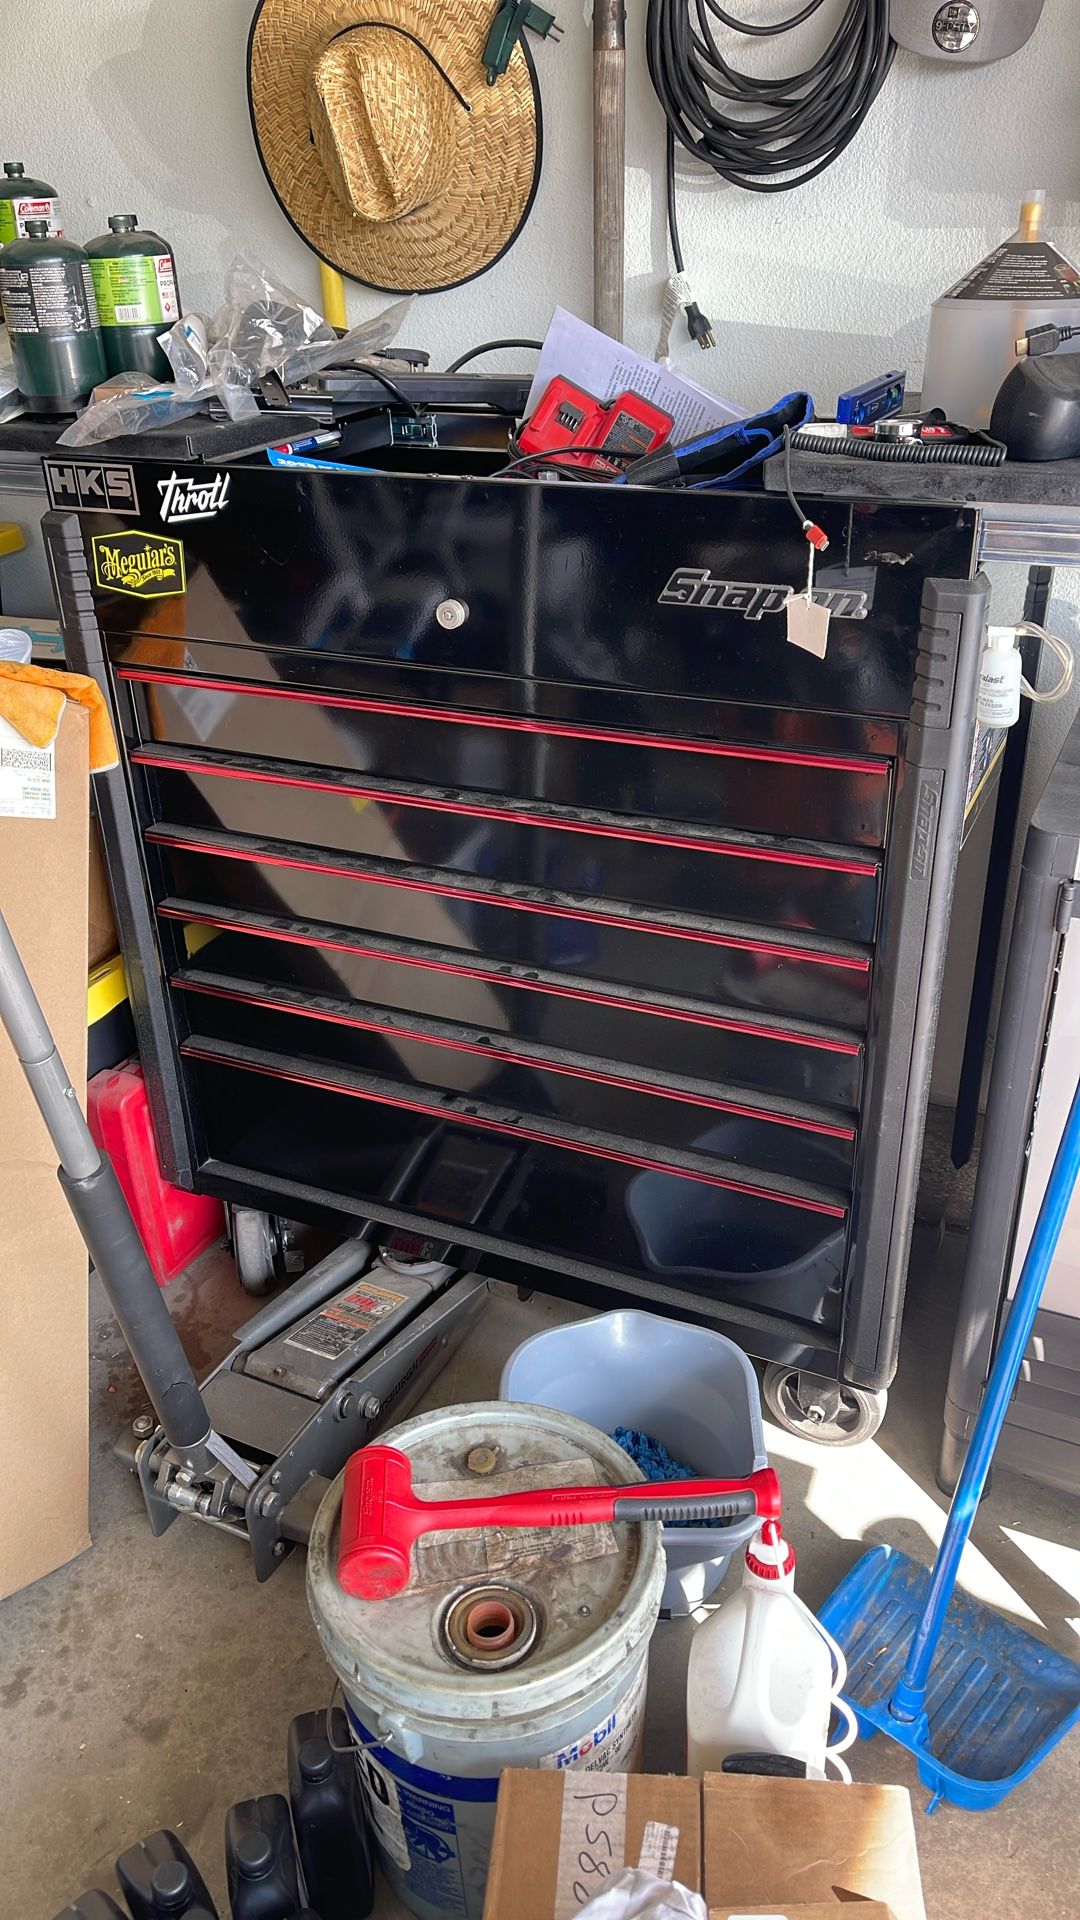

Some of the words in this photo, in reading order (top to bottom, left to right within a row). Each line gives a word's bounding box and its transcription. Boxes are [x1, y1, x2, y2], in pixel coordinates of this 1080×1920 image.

[19, 202, 45, 214] Coleman
[50, 467, 133, 498] HKS
[100, 543, 177, 583] Meguiar's
[557, 1713, 617, 1769] Mobil
